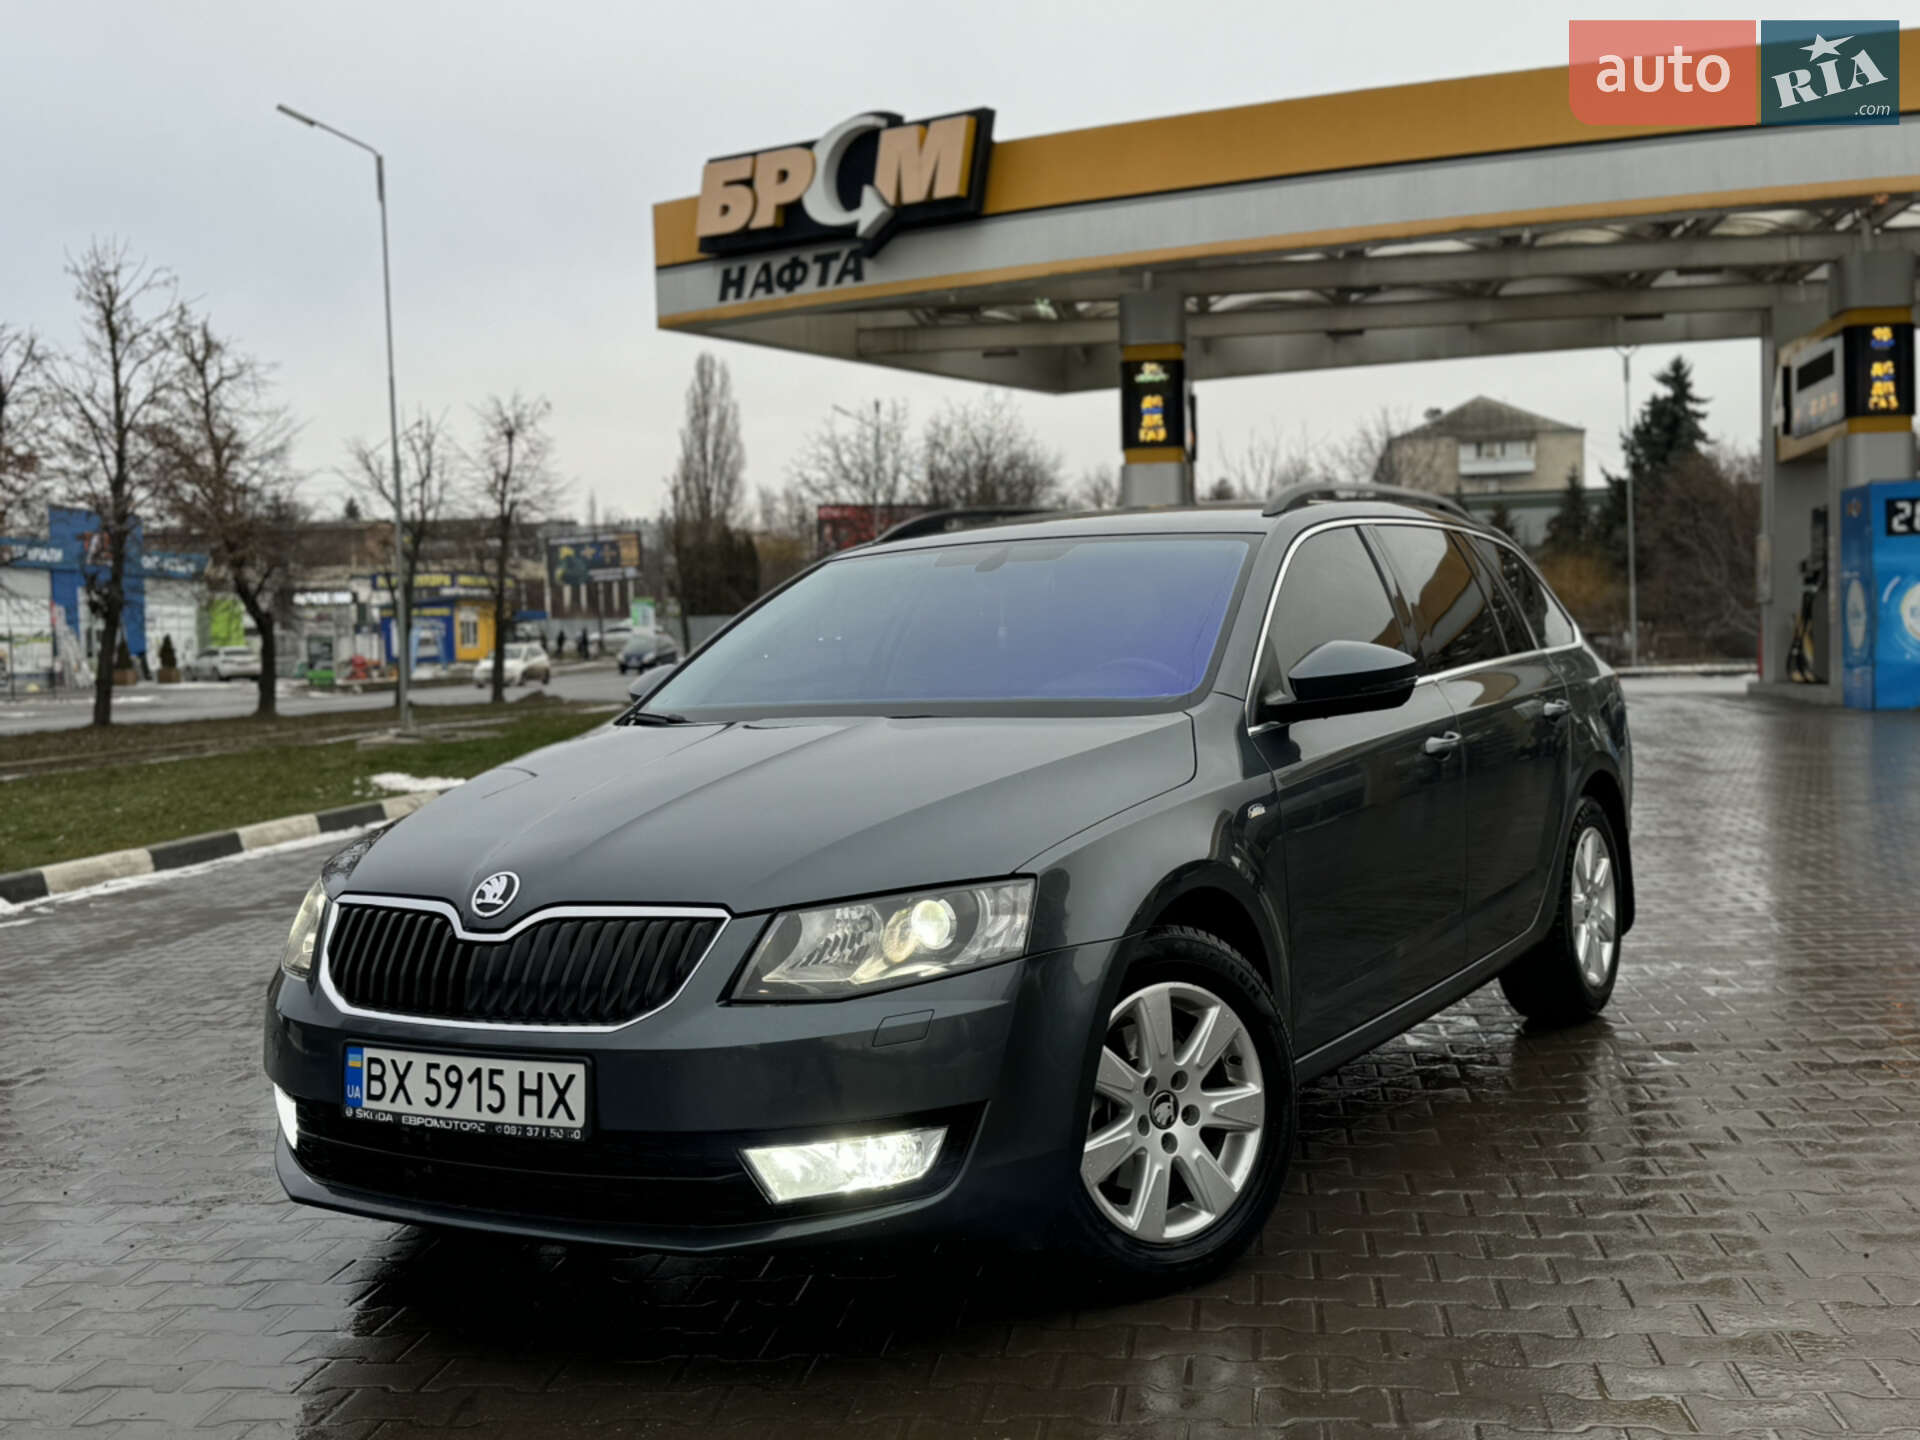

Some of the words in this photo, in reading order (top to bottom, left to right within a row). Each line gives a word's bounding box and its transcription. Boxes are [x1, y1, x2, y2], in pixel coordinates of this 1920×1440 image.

[697, 110, 978, 238] БРСМ
[718, 252, 865, 302] НАФТА
[347, 1084, 361, 1099] UA
[366, 1056, 413, 1105] BX
[424, 1062, 506, 1114] 5915
[518, 1070, 576, 1121] HX
